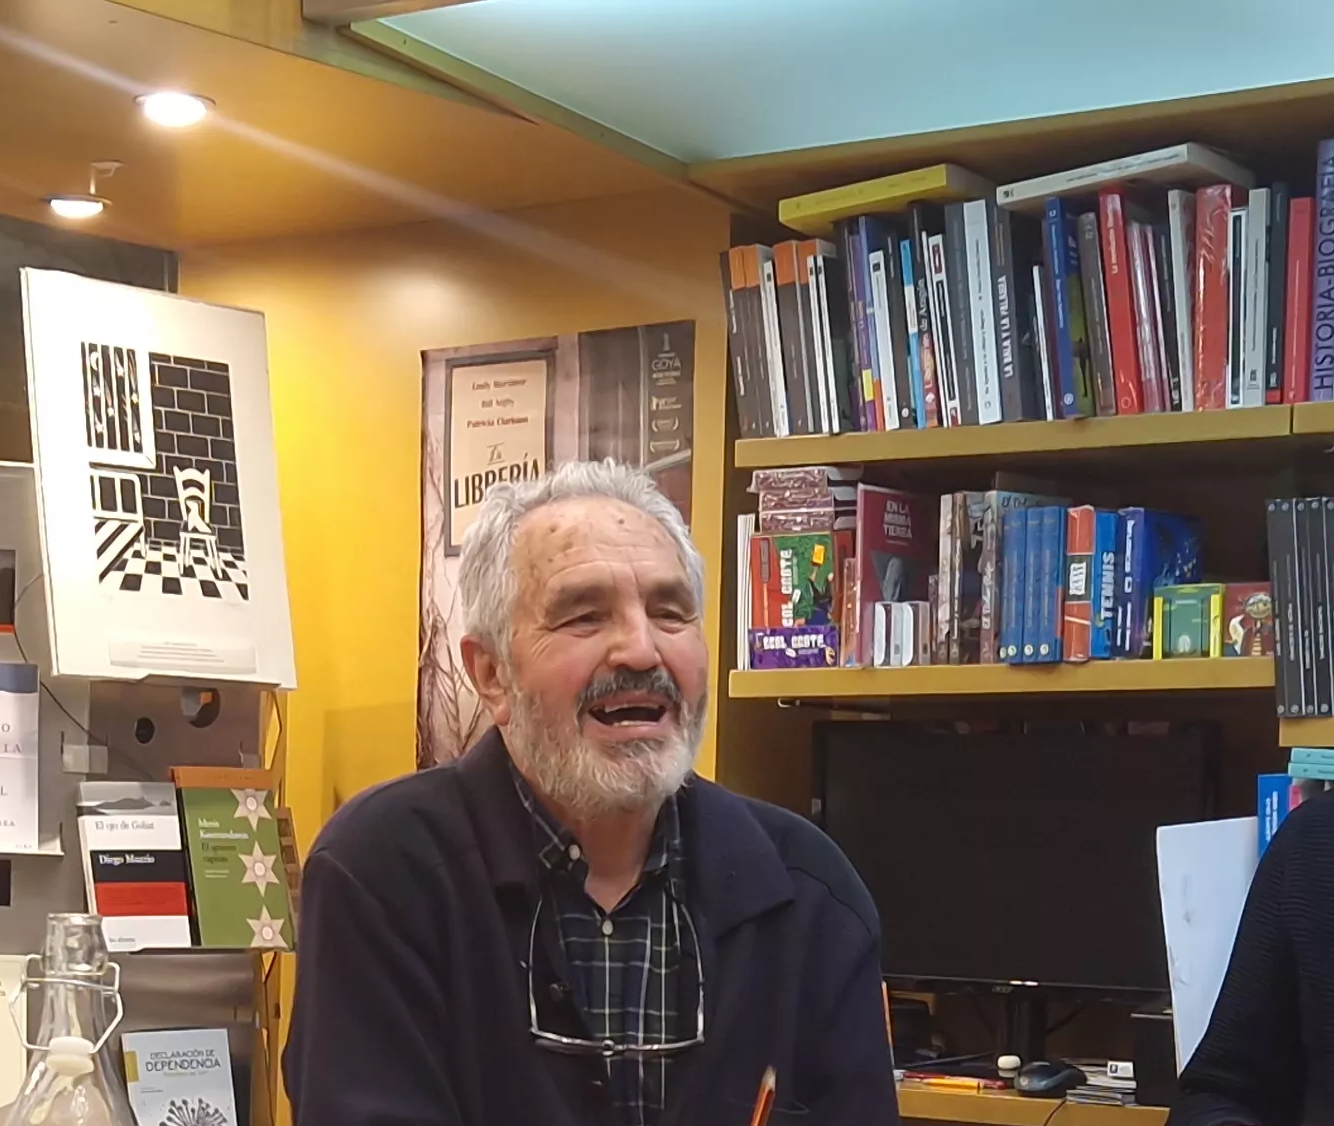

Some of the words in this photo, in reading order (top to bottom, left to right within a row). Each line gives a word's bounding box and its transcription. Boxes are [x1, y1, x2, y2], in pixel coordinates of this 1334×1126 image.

[651, 358, 682, 371] GOYA
[1099, 550, 1117, 620] TENNIS
[203, 1048, 216, 1060] DE
[145, 1058, 222, 1073] DEPENDENCIA
